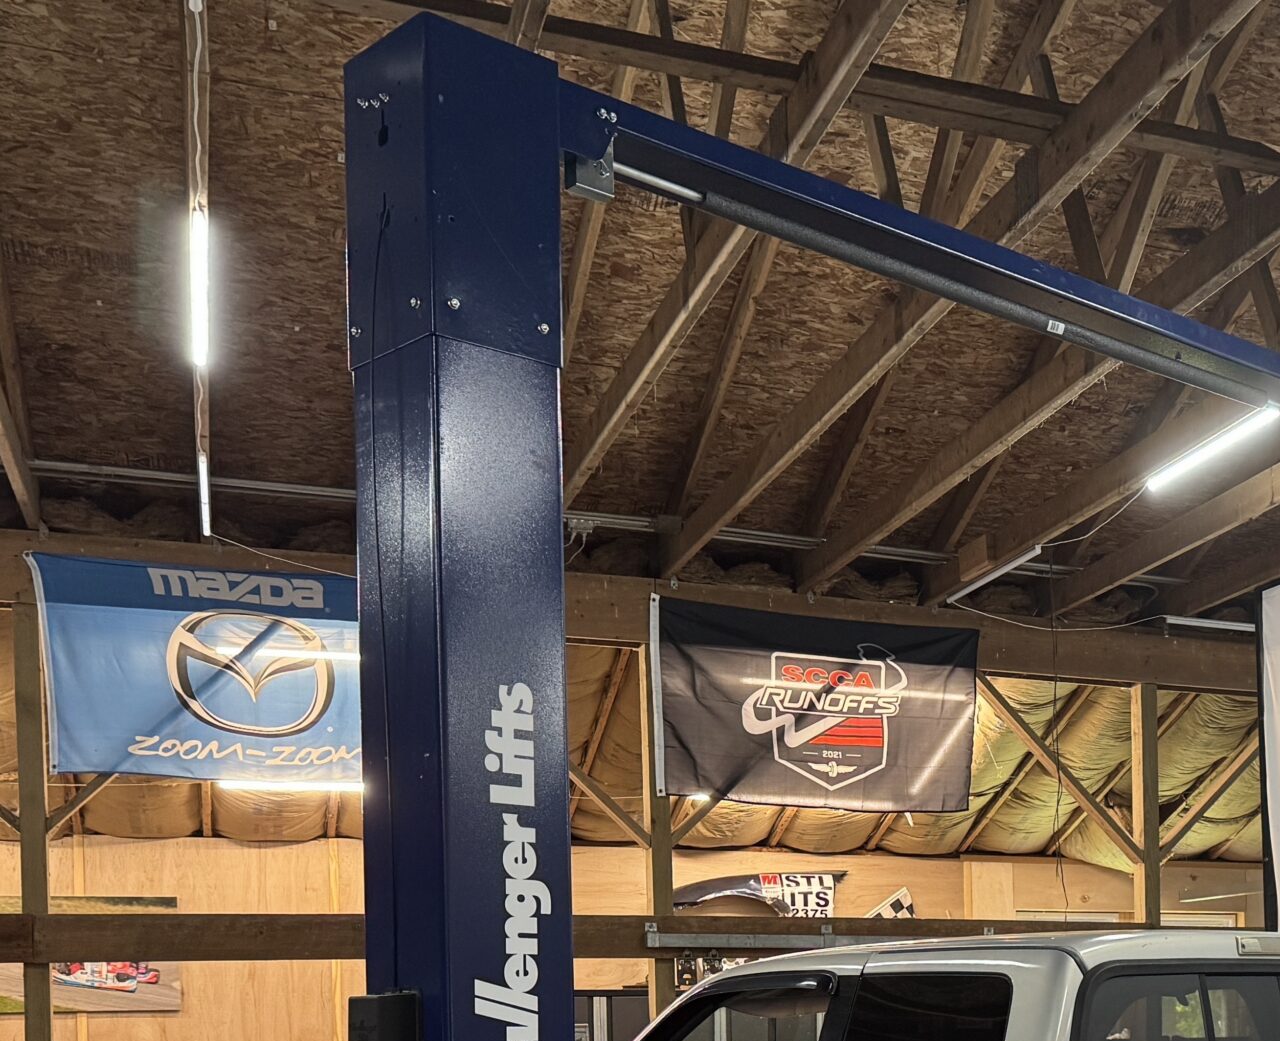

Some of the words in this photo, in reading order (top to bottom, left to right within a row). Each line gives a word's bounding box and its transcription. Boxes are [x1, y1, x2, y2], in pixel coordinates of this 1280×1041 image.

[781, 665, 875, 690] SCCA
[761, 686, 898, 714] RUNOFFS
[484, 682, 536, 807] Lifts
[822, 750, 842, 759] 2021
[784, 875, 833, 890] STL
[790, 891, 830, 908] ITS
[791, 908, 828, 918] 2375
